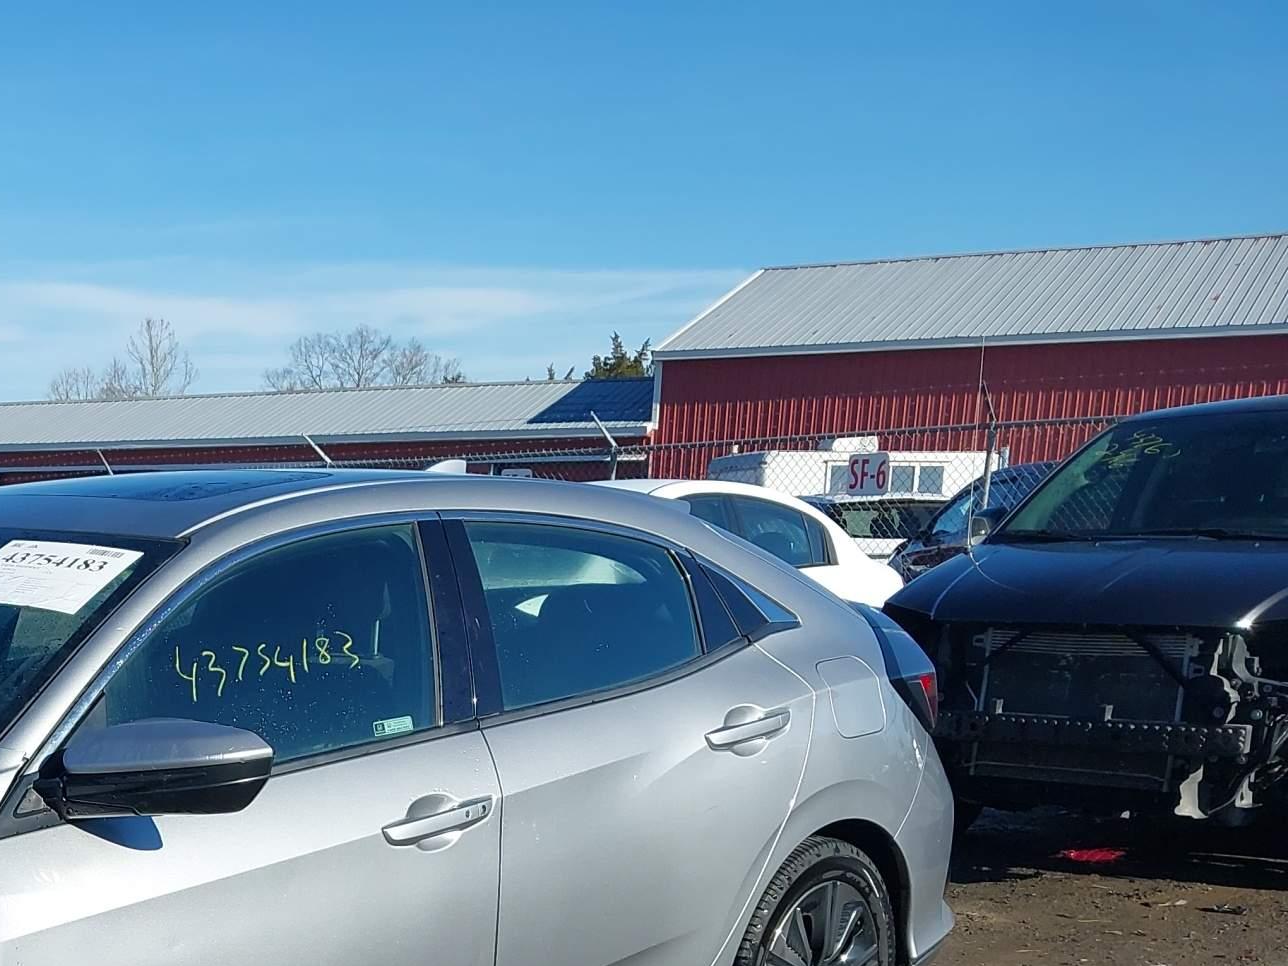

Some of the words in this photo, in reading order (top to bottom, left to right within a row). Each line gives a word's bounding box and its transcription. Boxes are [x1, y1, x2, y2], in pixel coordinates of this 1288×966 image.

[848, 458, 887, 490] SF-6
[1, 551, 109, 573] 43754183
[175, 631, 359, 702] 43754183
